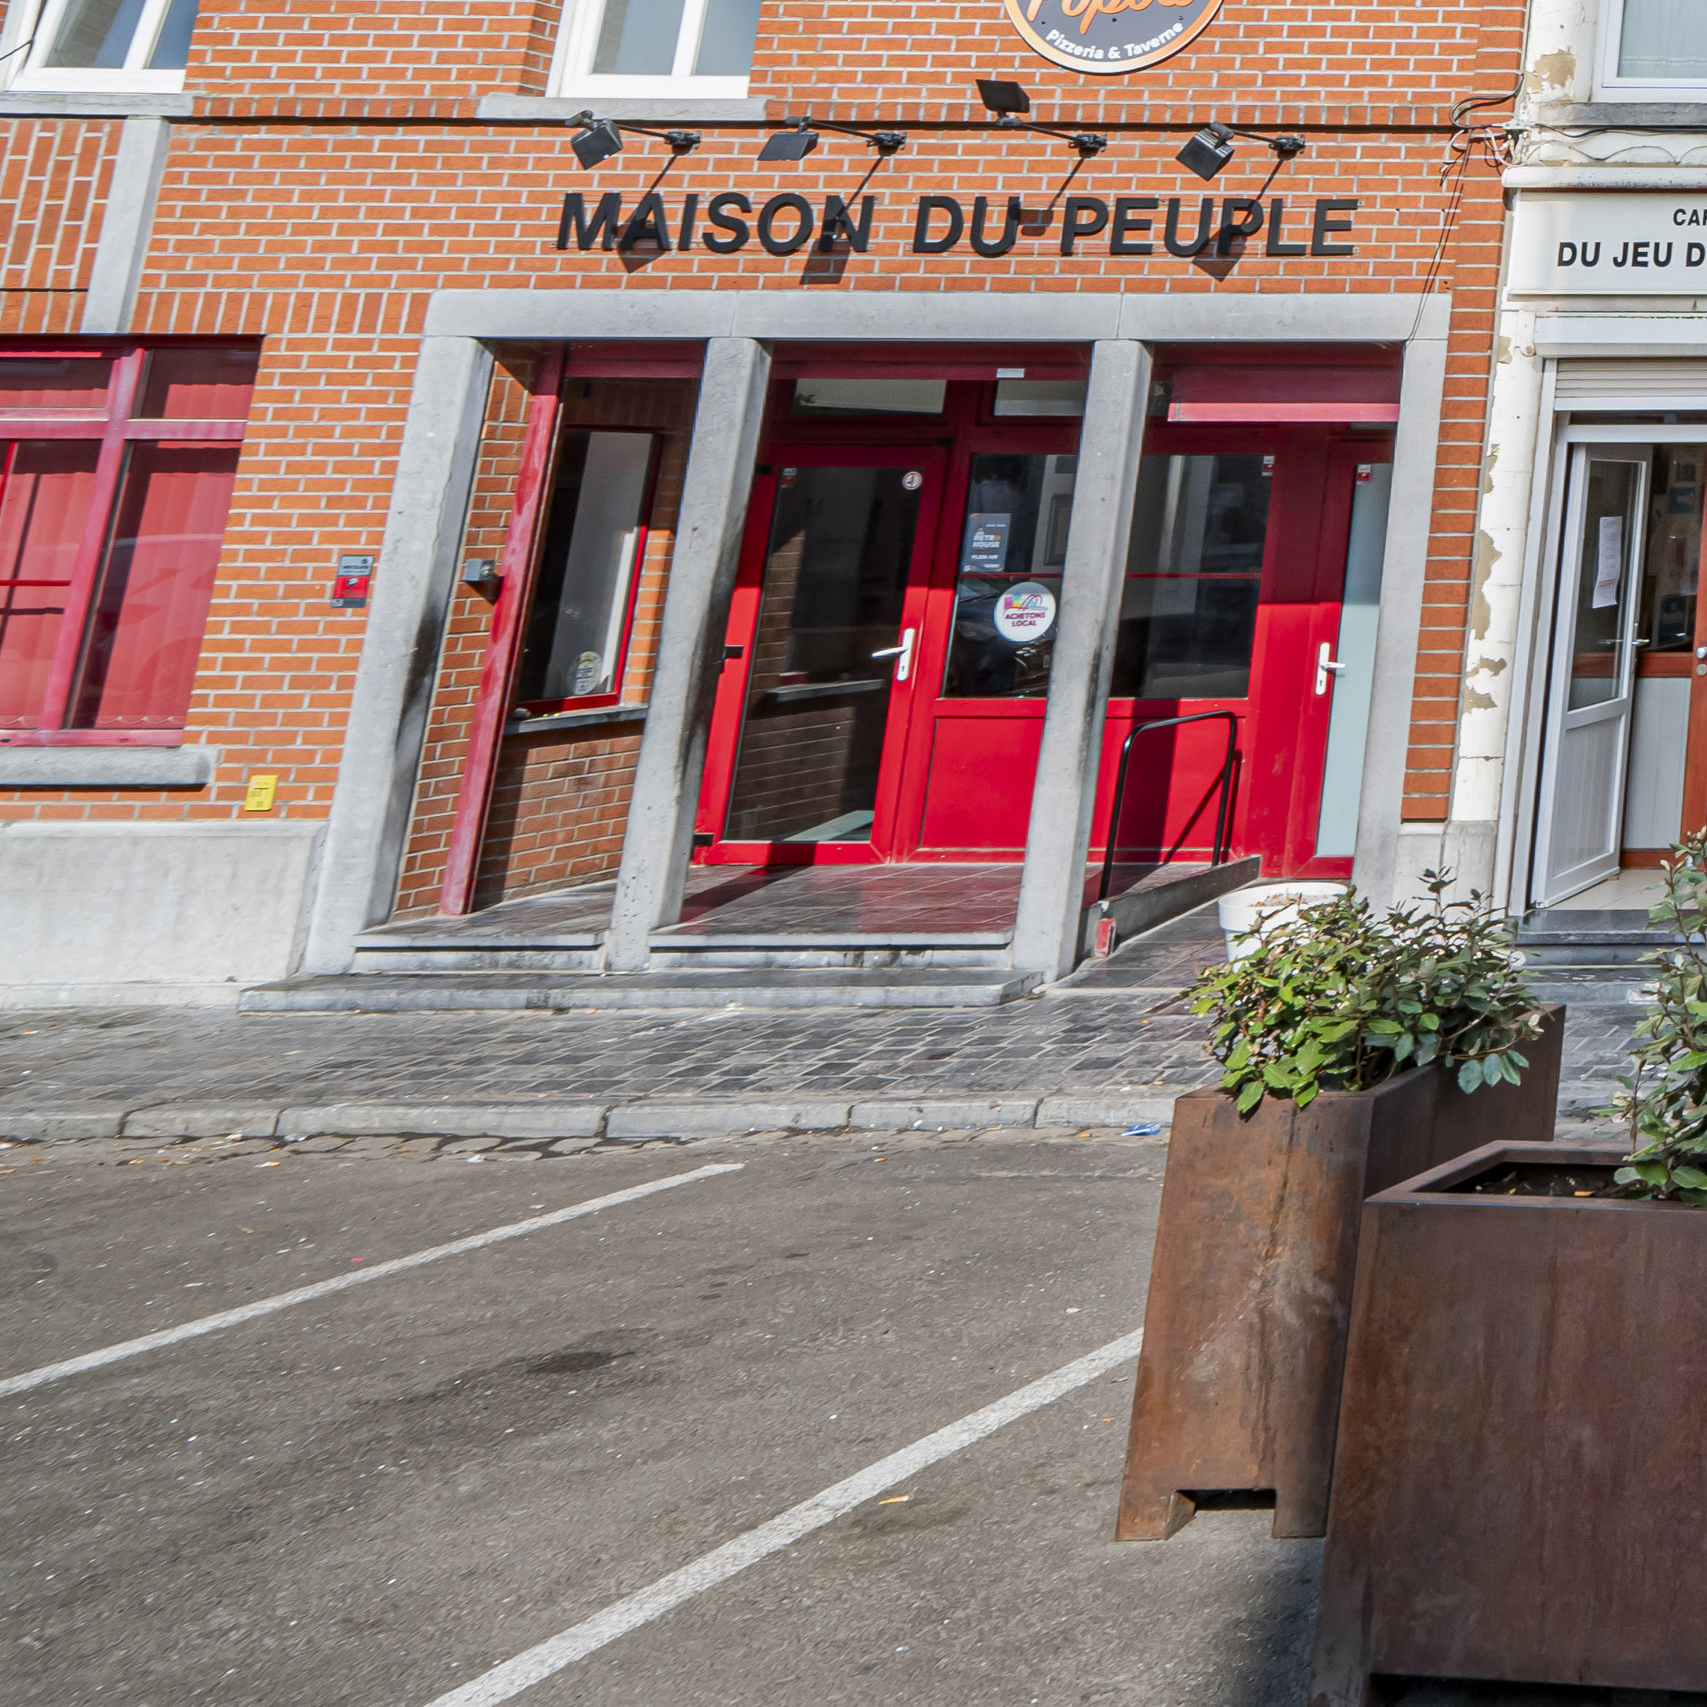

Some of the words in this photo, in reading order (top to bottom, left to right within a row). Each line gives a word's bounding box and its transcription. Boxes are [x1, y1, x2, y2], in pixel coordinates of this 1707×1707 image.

[1045, 28, 1105, 60] Pizzeria
[1107, 46, 1121, 60] &
[1123, 22, 1184, 57] Taverne
[556, 191, 874, 253] MAISON
[912, 195, 1020, 257] DU
[1060, 196, 1360, 258] PEUPLE
[1557, 241, 1601, 267] DU
[1612, 241, 1673, 268] JEU
